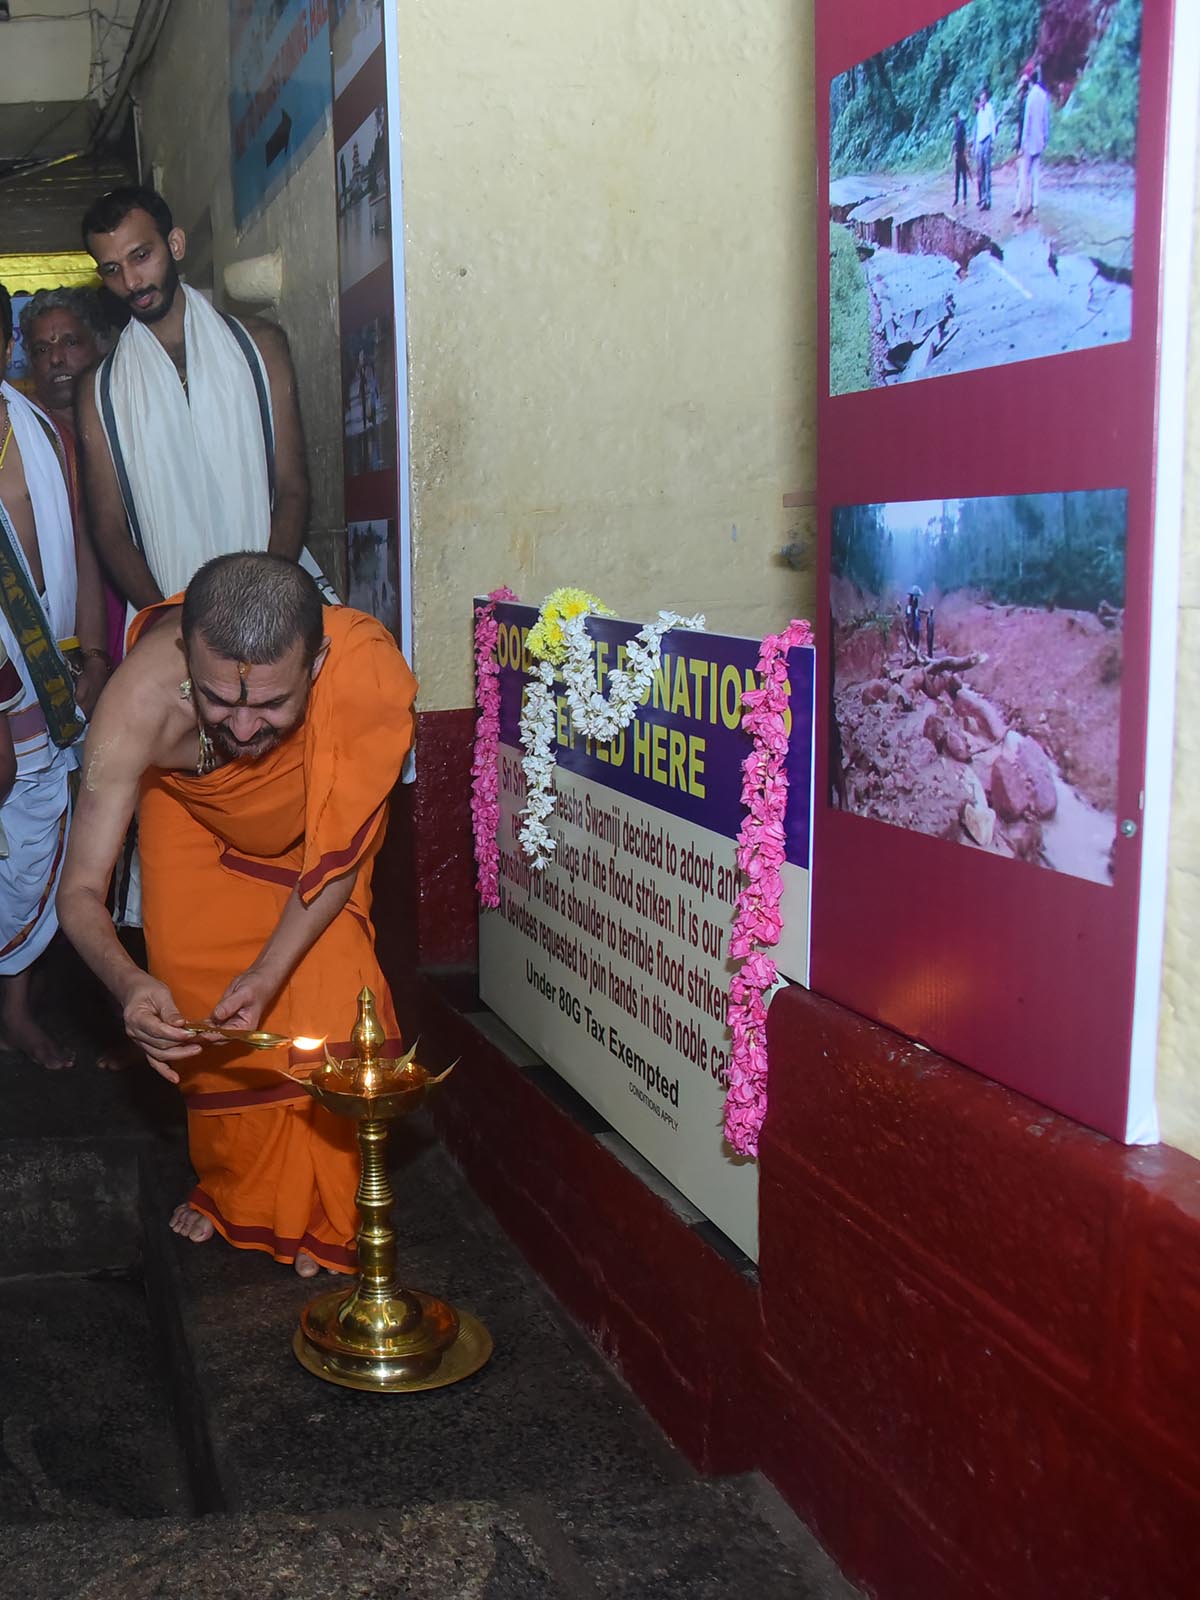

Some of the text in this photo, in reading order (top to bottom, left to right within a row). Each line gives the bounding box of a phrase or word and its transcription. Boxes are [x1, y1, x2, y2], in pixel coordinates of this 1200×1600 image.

[502, 756, 512, 792] Sri
[585, 793, 620, 857] Swamiji
[623, 811, 663, 869] decided
[666, 831, 677, 876] to
[680, 841, 714, 903] adopt
[634, 718, 706, 800] HERE
[543, 868, 559, 912] lend
[561, 888, 566, 917] a
[568, 886, 605, 943] shoulder
[607, 910, 617, 951] to
[618, 917, 654, 976] terrible
[657, 939, 685, 997] flood
[687, 965, 729, 1027] striken
[581, 845, 592, 884] of
[593, 850, 607, 893] the
[609, 856, 634, 909] flood
[636, 877, 675, 934] striken.
[678, 894, 686, 940] It
[688, 900, 699, 947] is
[702, 920, 724, 960] our
[507, 891, 538, 943] devotees
[540, 921, 578, 974] requested
[579, 943, 588, 981] to
[589, 947, 607, 995] join
[608, 961, 638, 1019] hands
[640, 984, 650, 1029] in
[652, 994, 673, 1045] this
[676, 1018, 708, 1072] noble
[526, 957, 679, 1108] Under 80G Tax Exempted
[628, 1081, 679, 1132] CONDITIONS APPLY
